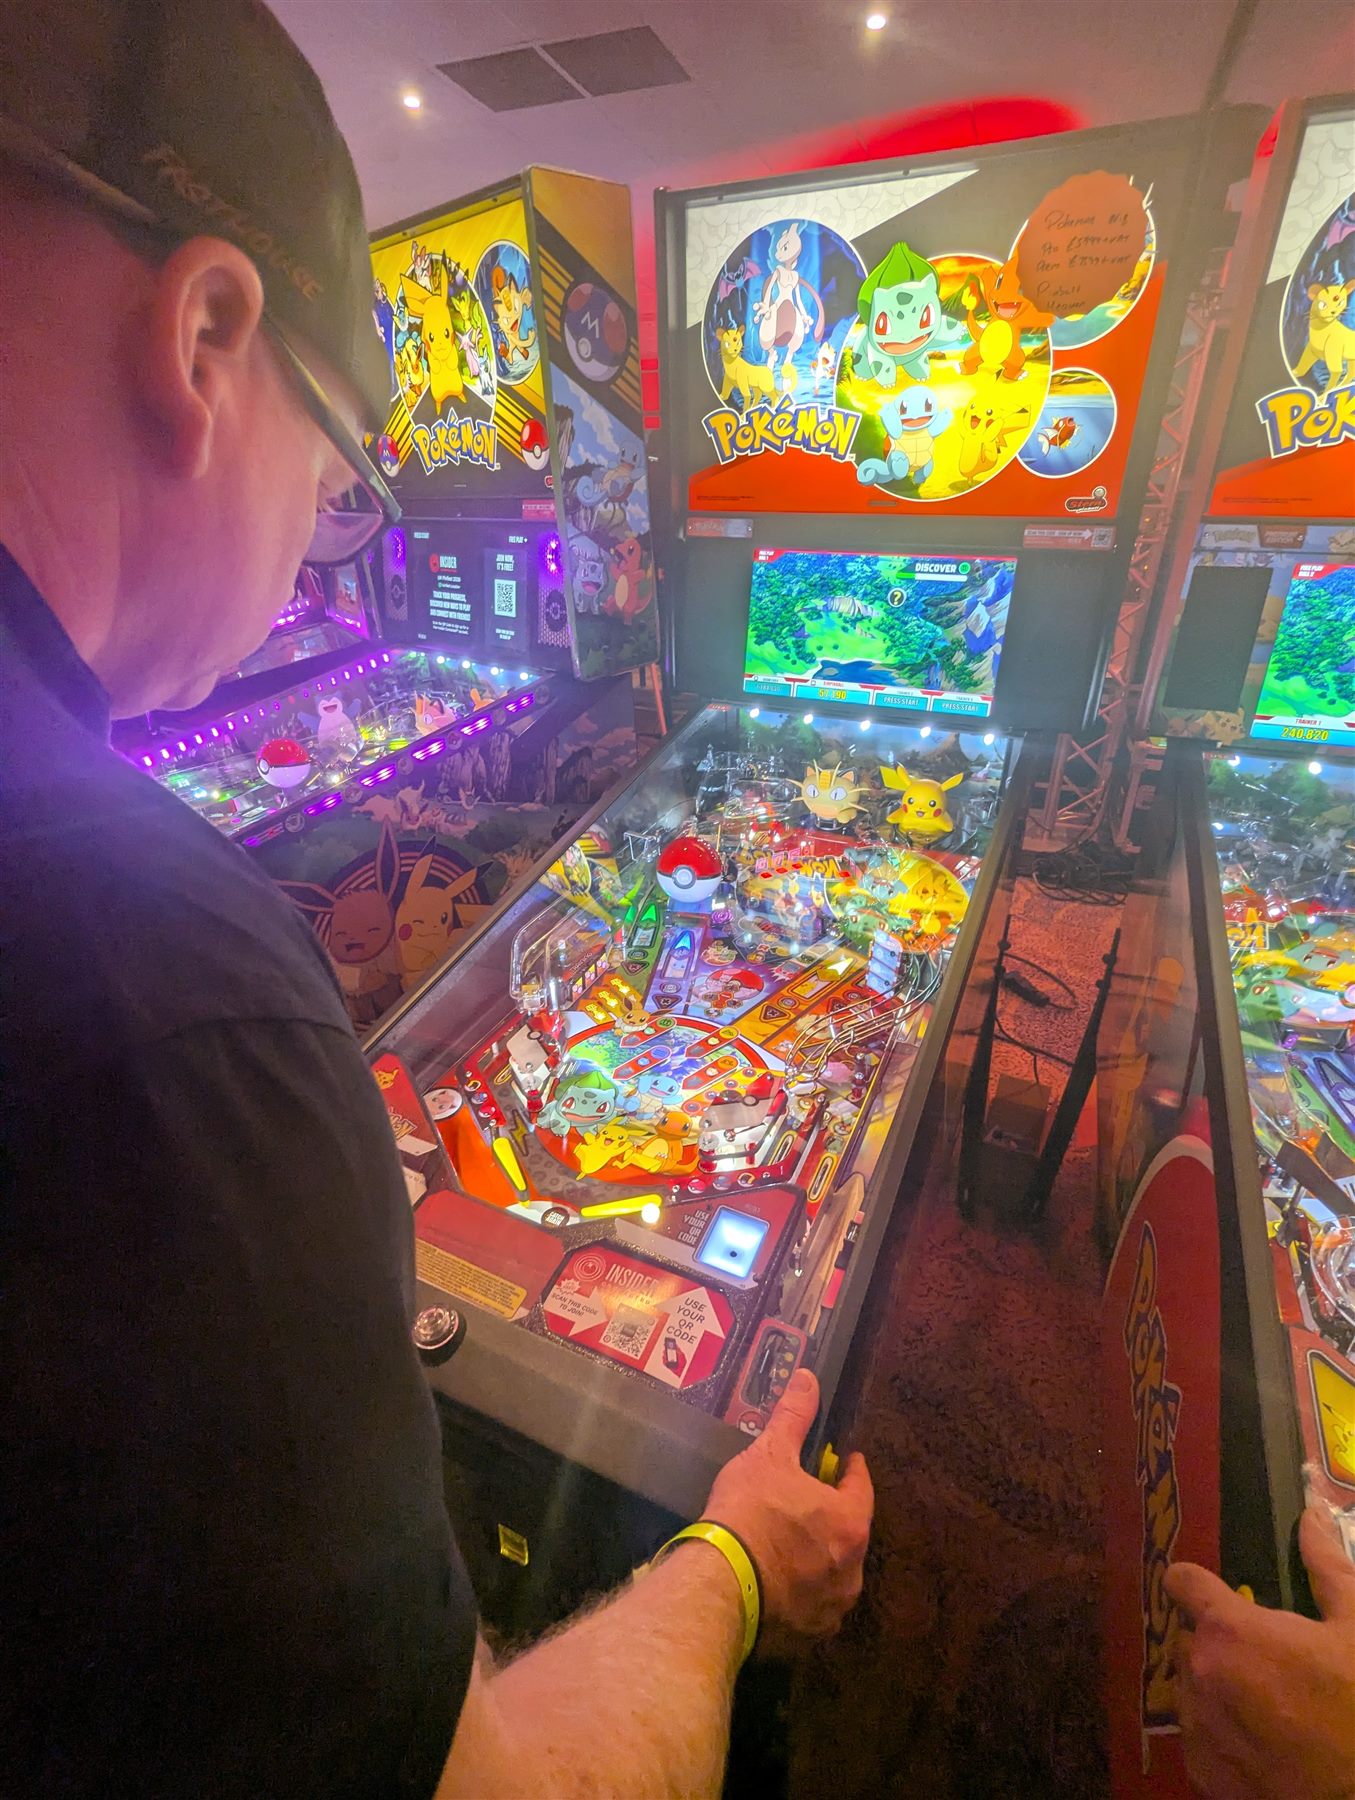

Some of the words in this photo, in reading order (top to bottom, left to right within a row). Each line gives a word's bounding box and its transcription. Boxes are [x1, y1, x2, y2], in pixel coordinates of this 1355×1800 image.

[581, 311, 600, 339] M
[701, 393, 863, 466] Pokémon
[410, 406, 498, 476] Pokémon
[915, 562, 957, 573] DISCOVER
[683, 1214, 706, 1229] YOUR
[694, 1209, 710, 1222] USE
[677, 1231, 698, 1245] CODE
[551, 1292, 568, 1303] SCAN
[568, 1298, 582, 1309] THIS
[581, 1304, 598, 1315] CODE
[559, 1303, 568, 1311] TO
[568, 1306, 584, 1317] JOIN!
[684, 1297, 707, 1313] USE
[676, 1305, 706, 1324] YOUR
[678, 1318, 694, 1331] QR
[666, 1325, 697, 1345] CODE
